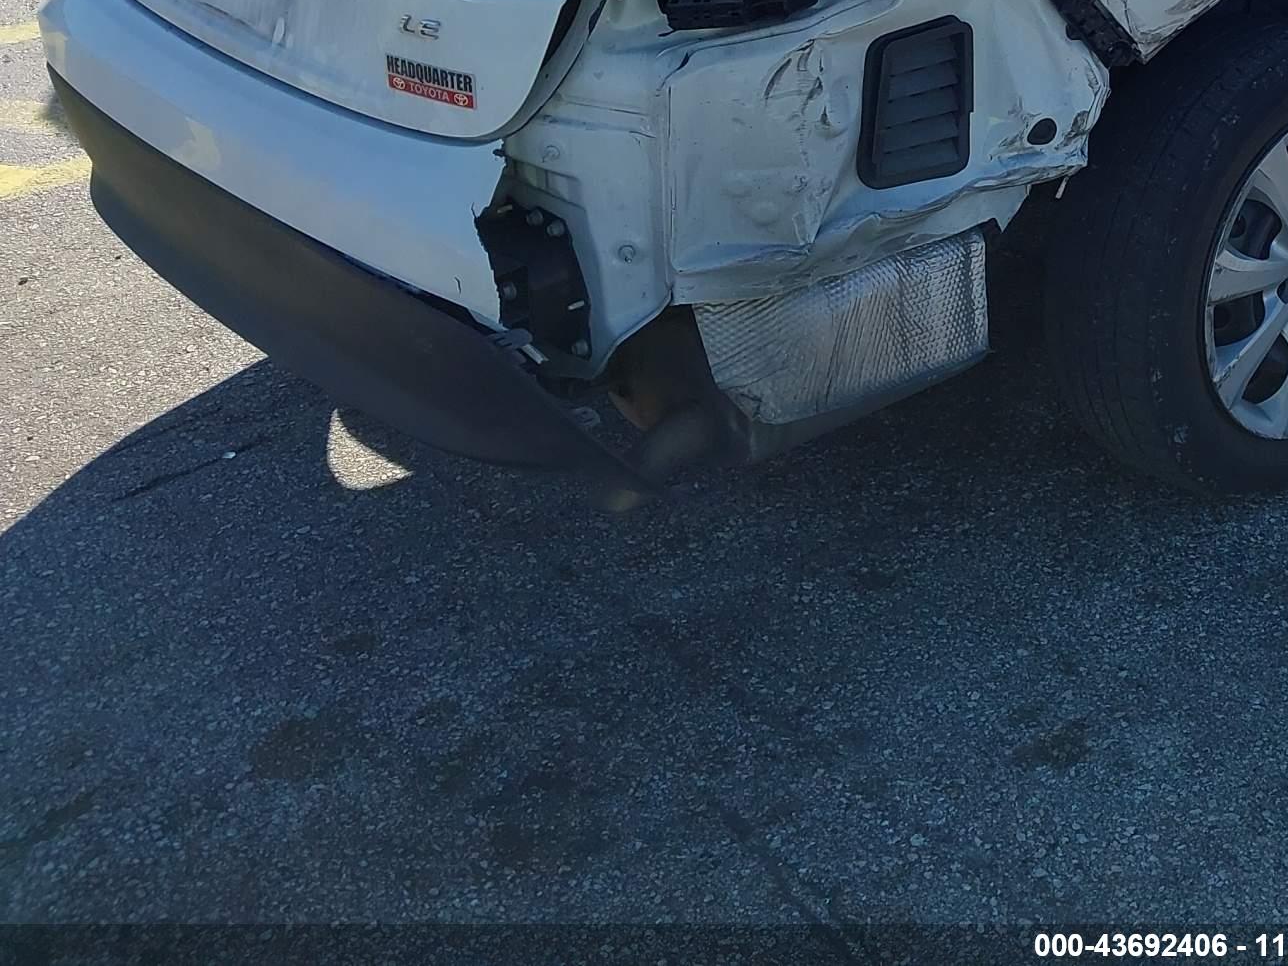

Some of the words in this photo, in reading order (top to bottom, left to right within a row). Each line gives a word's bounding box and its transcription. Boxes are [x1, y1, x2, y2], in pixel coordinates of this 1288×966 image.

[400, 14, 442, 40] LE
[386, 54, 473, 93] HEADQUARTER
[409, 81, 450, 102] TOYOTA
